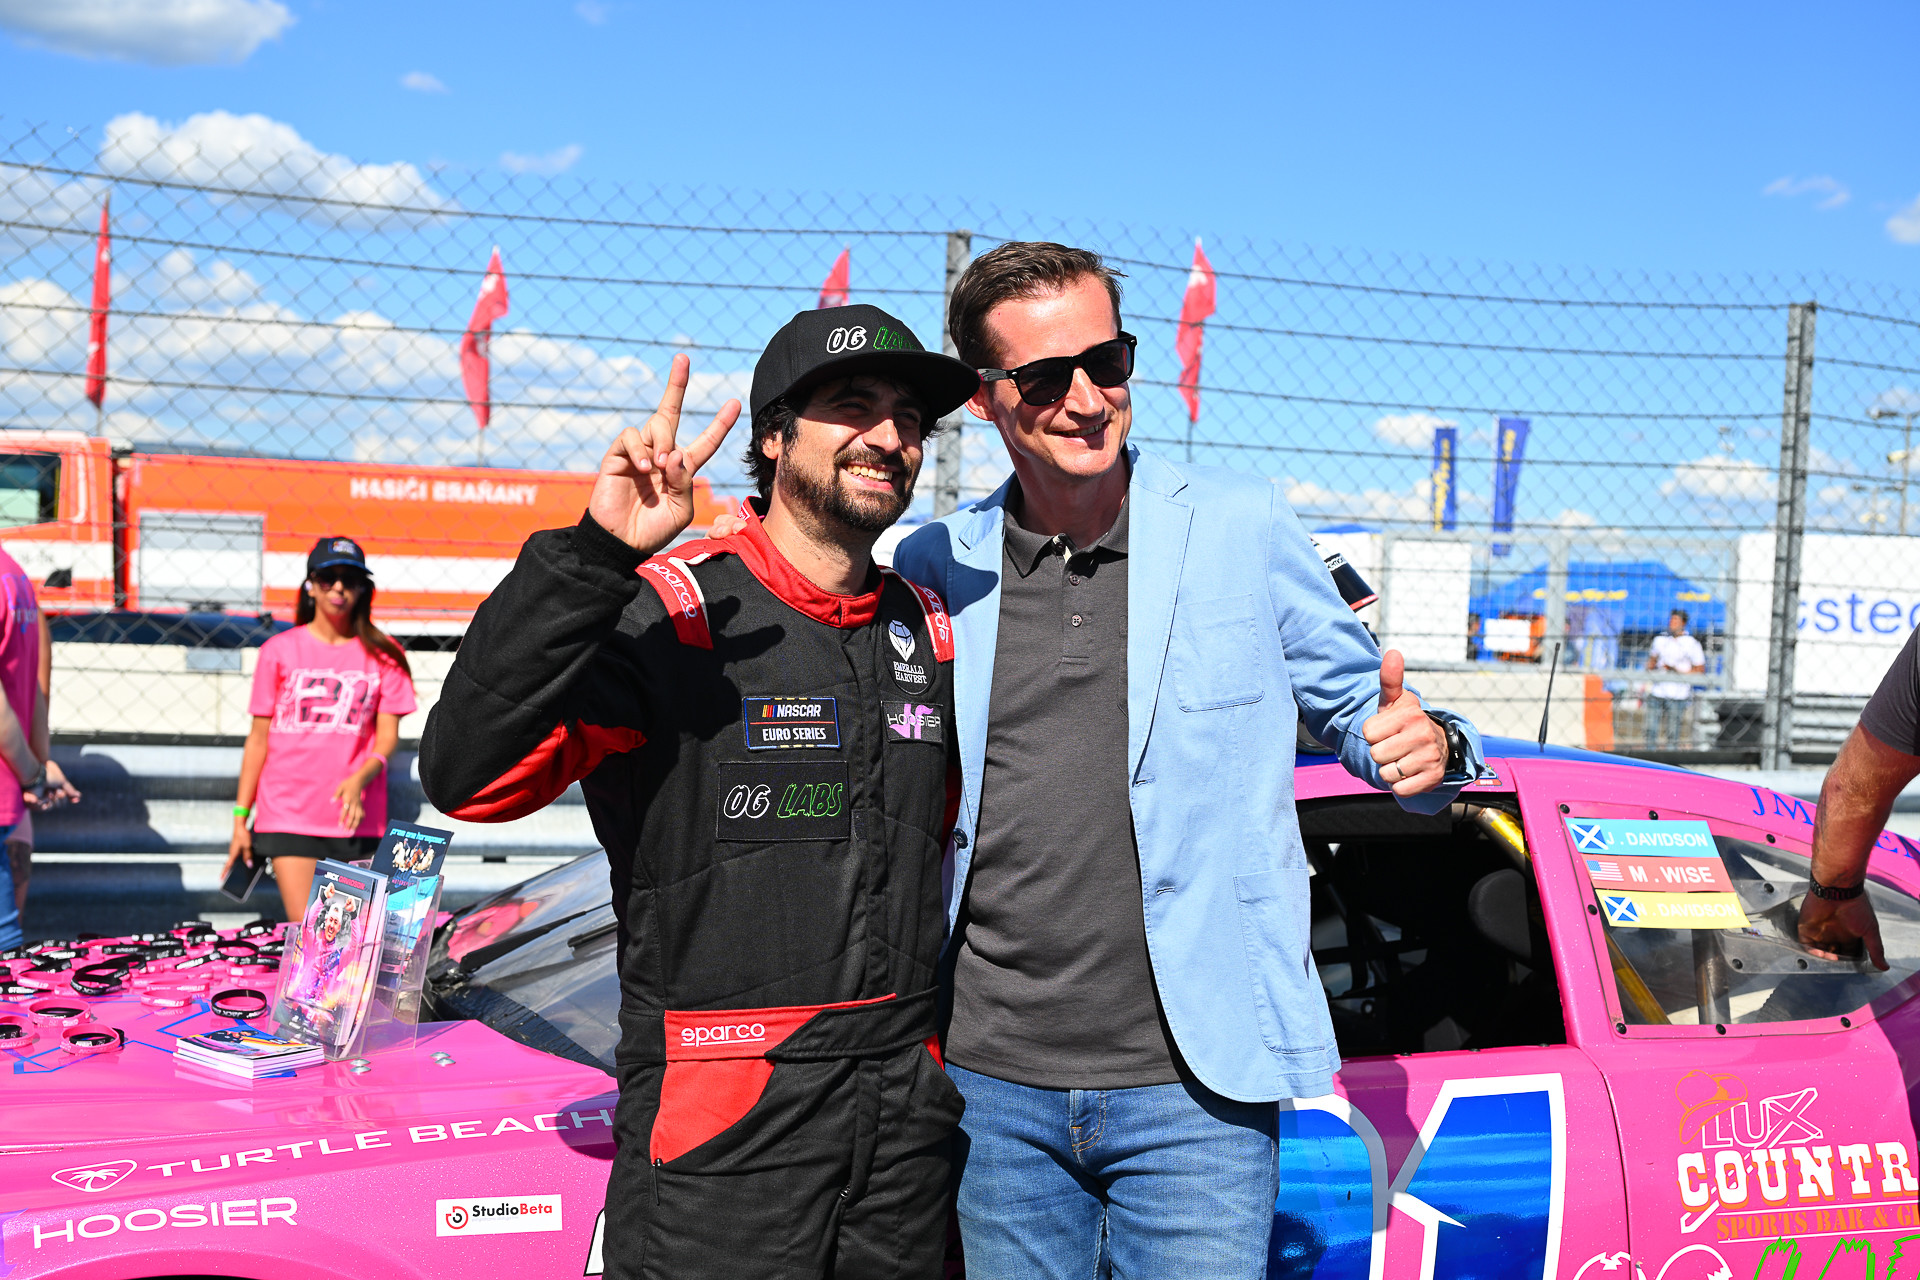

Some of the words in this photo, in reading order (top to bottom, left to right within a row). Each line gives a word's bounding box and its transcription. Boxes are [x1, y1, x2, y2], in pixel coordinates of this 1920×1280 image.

[826, 325, 868, 354] OG
[893, 661, 924, 675] EMERALD
[895, 670, 927, 684] HARVEST
[776, 704, 821, 718] NASCAR
[887, 713, 941, 728] HOOSIER
[762, 728, 791, 741] EURO
[792, 727, 827, 740] SERIES
[723, 783, 772, 819] OG
[776, 782, 843, 818] LABS
[1625, 832, 1708, 847] DAVIDSON
[1659, 866, 1716, 884] WISE
[1657, 903, 1739, 918] DAVIDSON
[681, 1023, 766, 1047] sparco
[1701, 1087, 1824, 1150] LUX
[146, 1130, 392, 1177] TURTLE
[409, 1109, 613, 1144] BEACH
[472, 1202, 553, 1217] StudioBeta
[33, 1196, 298, 1249] HOOSIER
[1716, 1212, 1808, 1240] SPORTS
[1816, 1207, 1864, 1232] BAR
[1873, 1207, 1888, 1228] &
